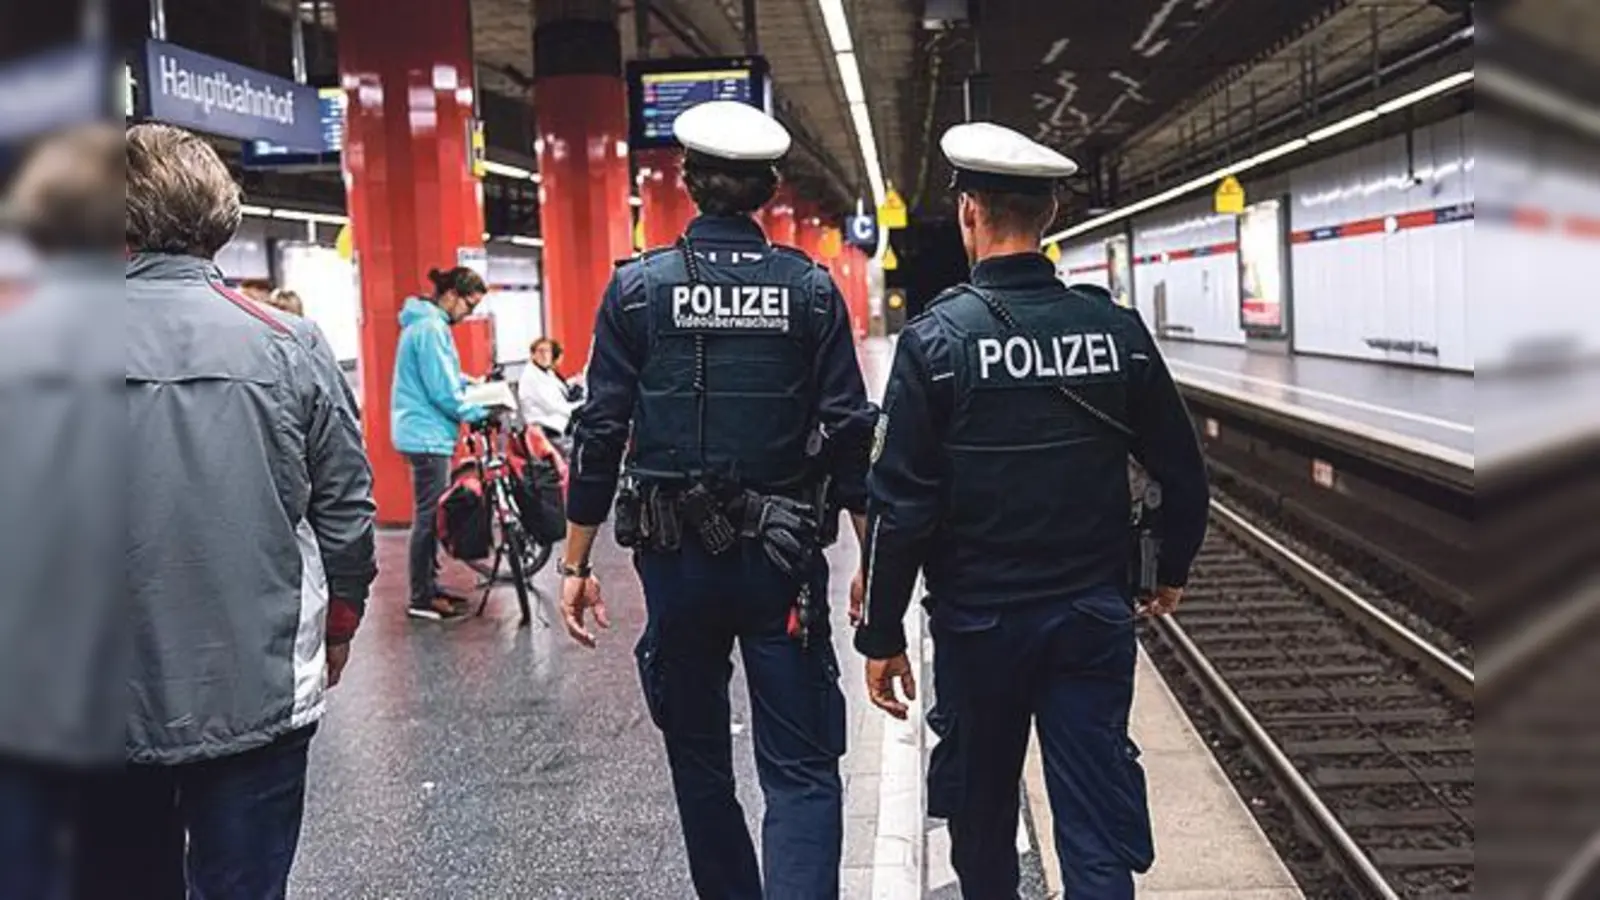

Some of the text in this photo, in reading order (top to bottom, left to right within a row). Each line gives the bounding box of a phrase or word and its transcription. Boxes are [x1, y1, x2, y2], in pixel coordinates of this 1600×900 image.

[160, 54, 295, 125] Hauptbahnhof
[852, 215, 873, 240] C
[672, 284, 790, 318] POLIZEI
[673, 313, 790, 333] Videoüberwachung
[977, 333, 1121, 379] POLIZEI
